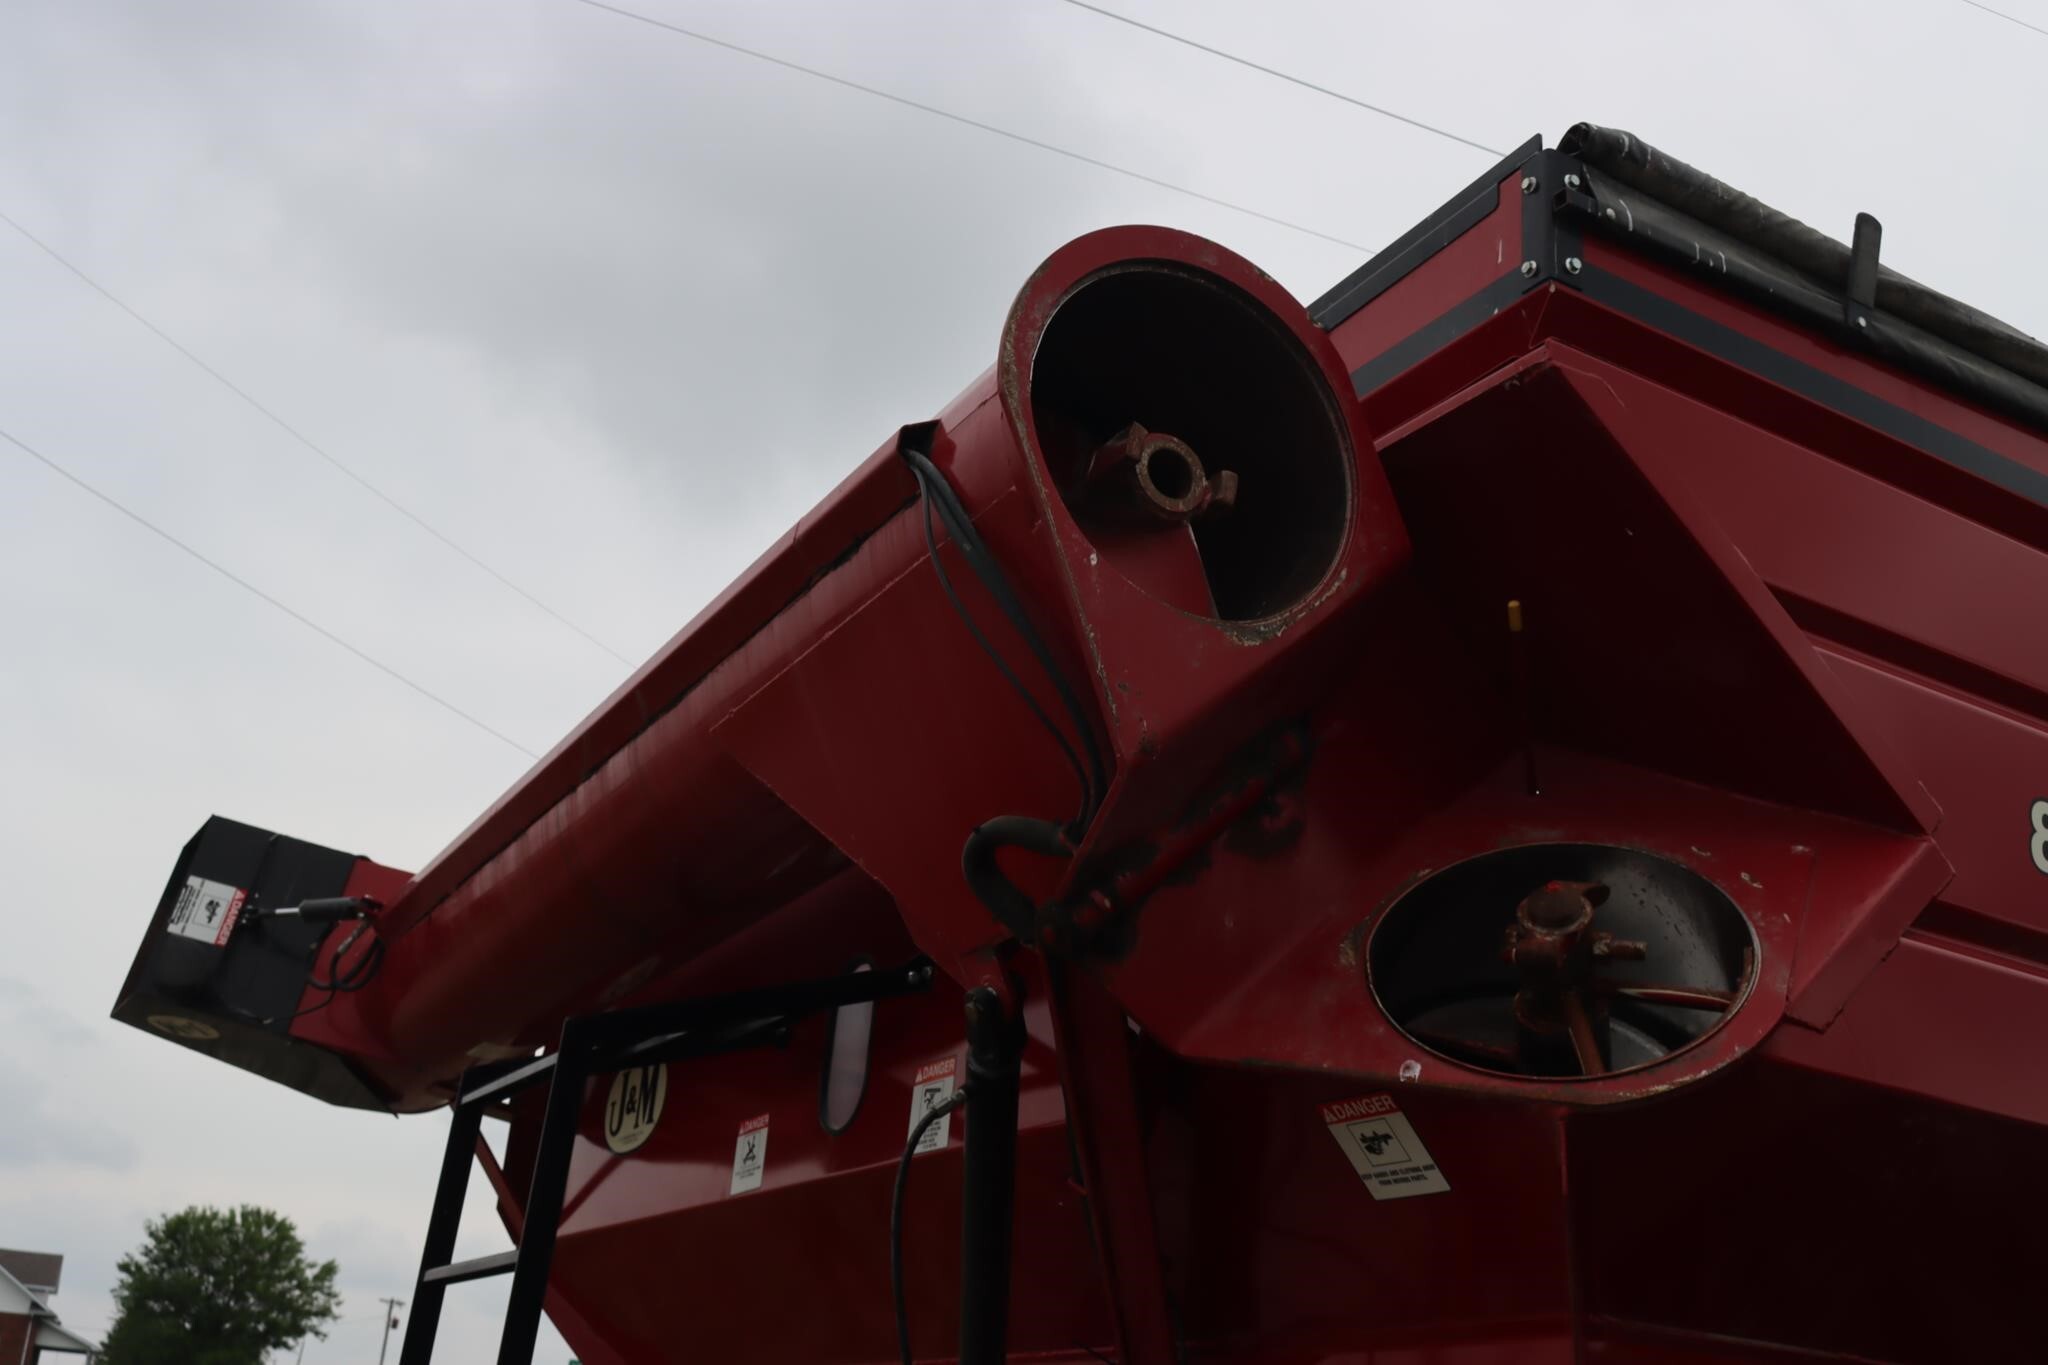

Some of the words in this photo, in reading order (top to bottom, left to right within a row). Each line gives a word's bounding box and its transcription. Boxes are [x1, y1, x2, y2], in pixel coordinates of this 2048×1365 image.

[922, 1058, 956, 1080] DANGER
[609, 1062, 659, 1136] J&M
[1333, 1095, 1397, 1120] DANGER
